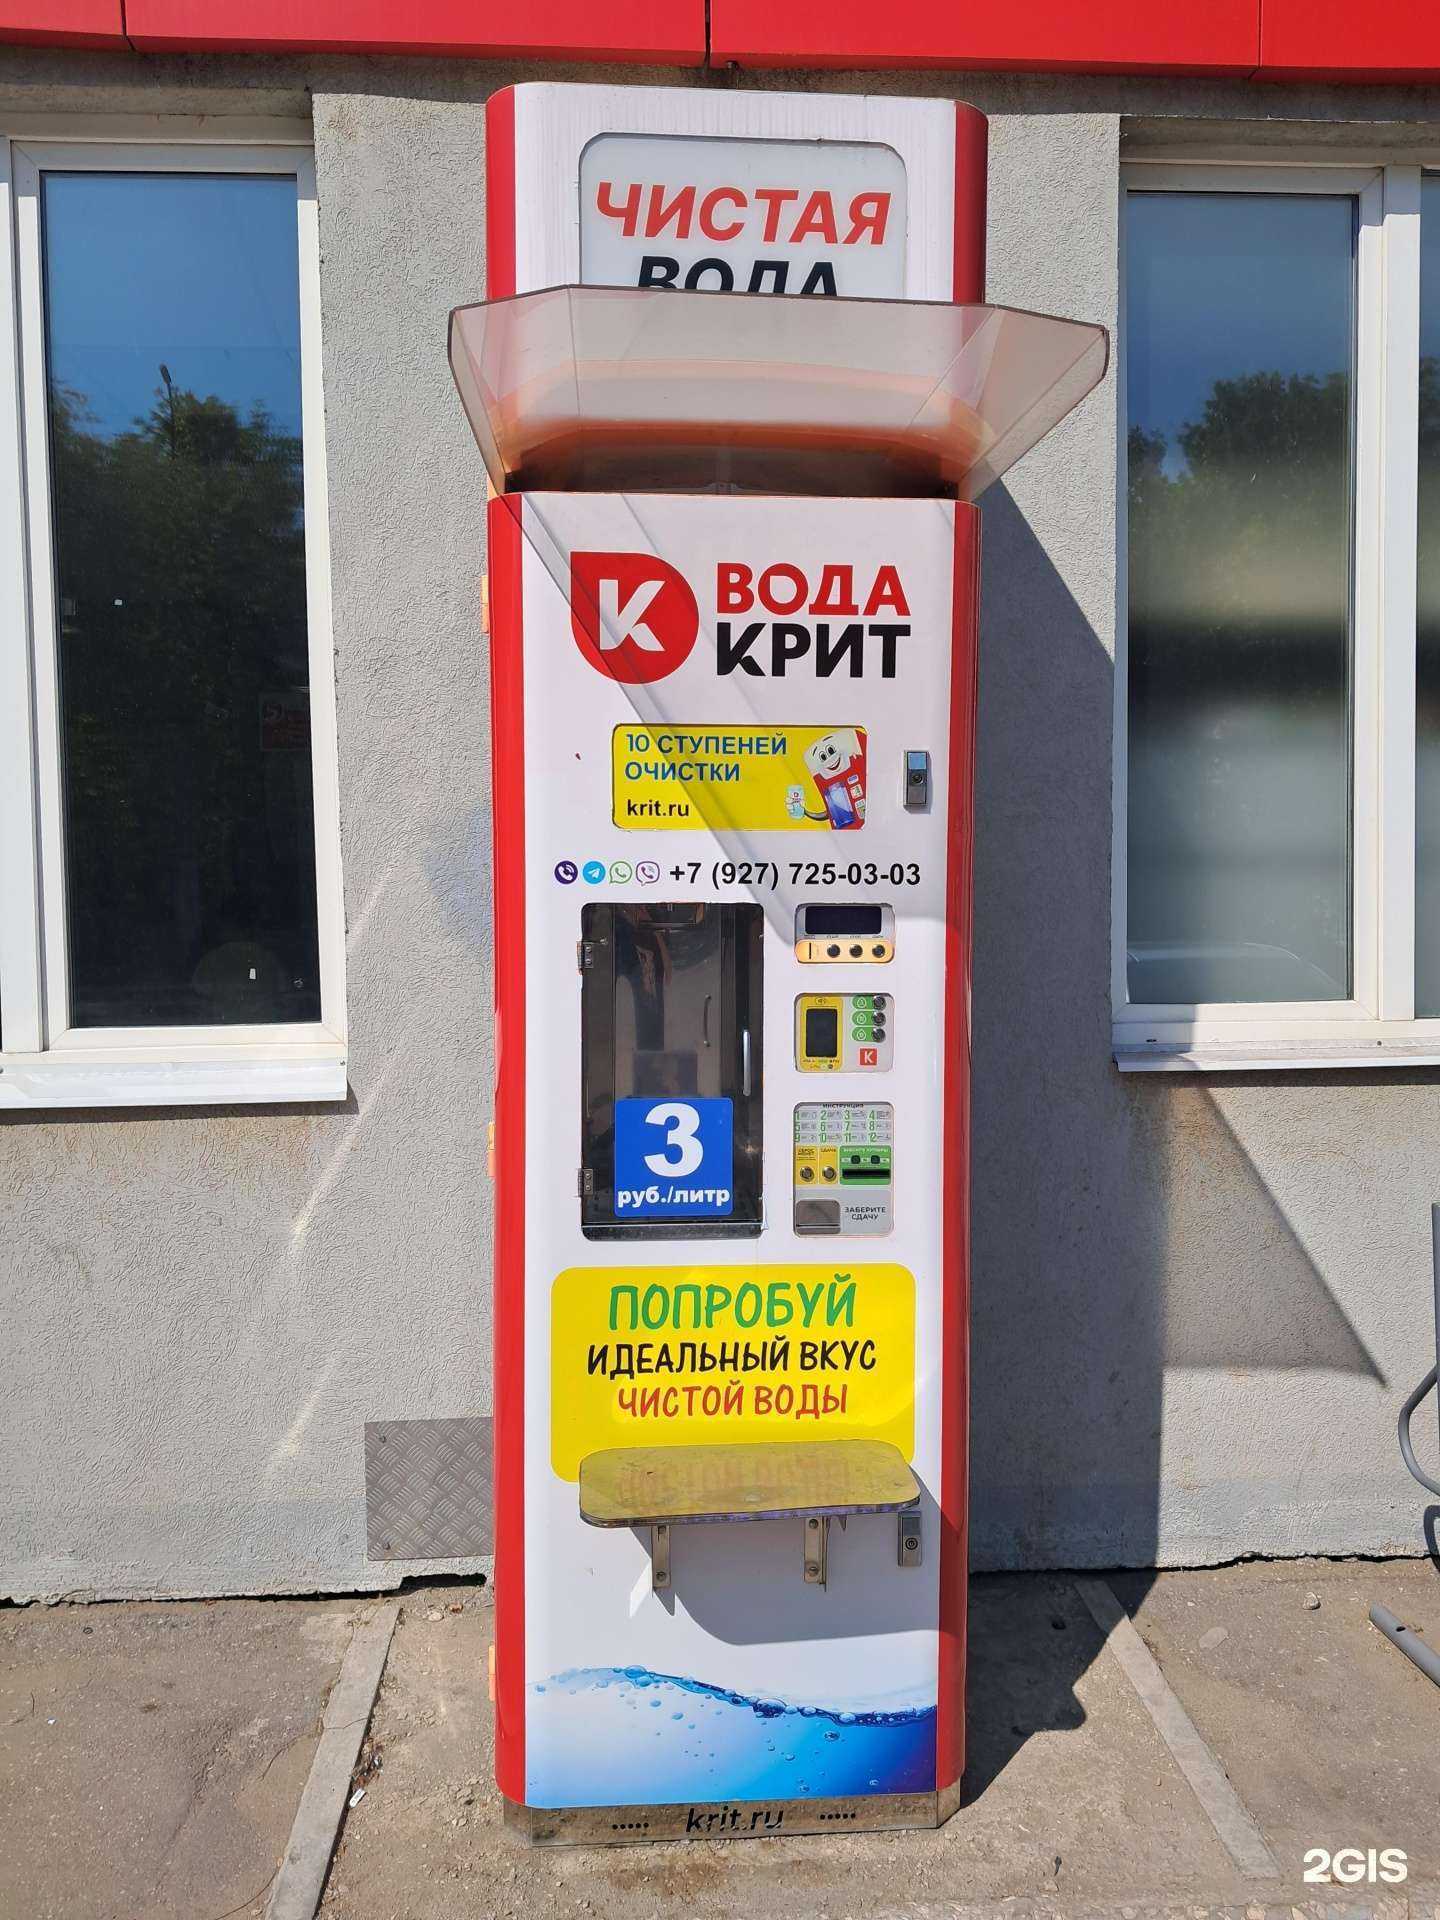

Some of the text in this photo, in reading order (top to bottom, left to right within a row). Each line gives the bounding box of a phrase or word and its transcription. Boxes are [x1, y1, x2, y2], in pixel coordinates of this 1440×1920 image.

[596, 182, 892, 246] ЧИСТАЯ
[716, 562, 911, 616] ВОДА
[716, 622, 911, 679] КРИТ
[626, 731, 787, 756] 10 СТУПЕНЕЙ
[624, 763, 740, 782] ОЧИСТКИ
[626, 797, 690, 818] krit.ru
[669, 862, 921, 890] +7 (927) 725-03-03
[820, 1110, 827, 1121] 2
[844, 1110, 850, 1120] 3
[869, 1110, 875, 1120] 4
[643, 1102, 704, 1178] 3
[617, 1185, 731, 1208] руб./литр
[608, 1272, 858, 1331] ПОПРОБУЙ
[587, 1334, 877, 1380] ИДЕАЛЬНЫЙ ВКУС
[617, 1379, 849, 1420] ЧИСТОЙ ВОДЫ
[685, 1805, 784, 1833] krit.ru
